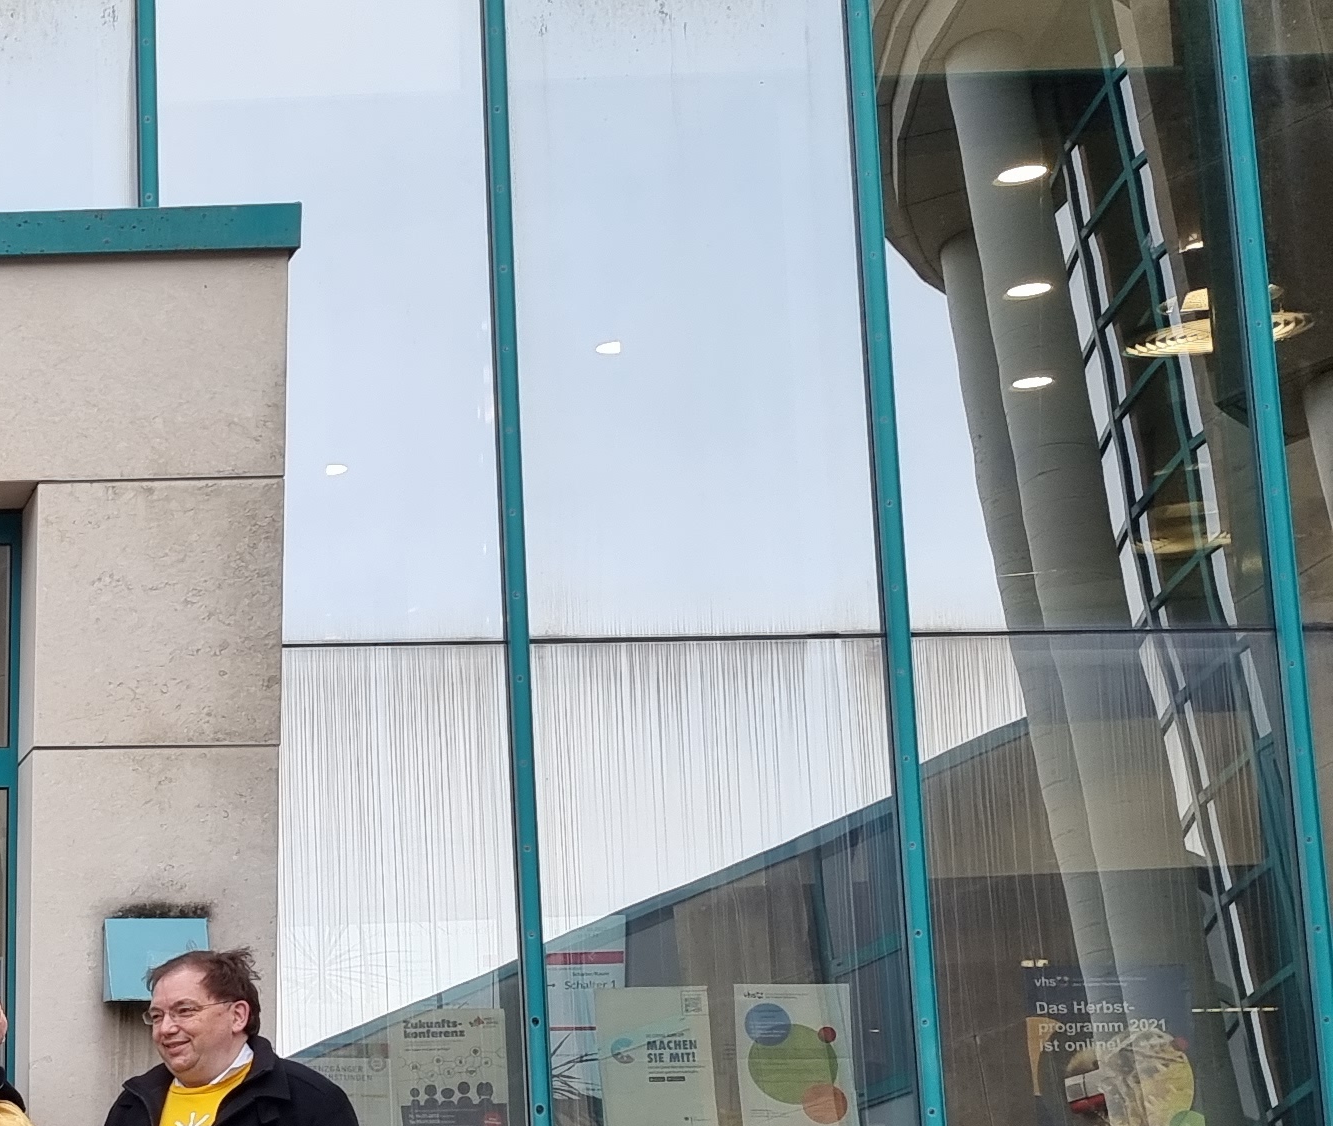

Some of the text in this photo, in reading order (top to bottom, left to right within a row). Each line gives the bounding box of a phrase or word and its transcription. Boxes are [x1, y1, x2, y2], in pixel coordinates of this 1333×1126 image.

[564, 980, 616, 990] Schalter 1
[1034, 976, 1057, 987] vhs
[1035, 1000, 1136, 1015] Das Herbst-
[402, 1018, 463, 1029] Zukunfts-
[1038, 1018, 1166, 1036] programm 2021
[403, 1029, 466, 1039] konferenz
[646, 1039, 698, 1051] MACHEN
[1039, 1038, 1121, 1052] ist online!
[647, 1051, 697, 1063] SIE MIT!
